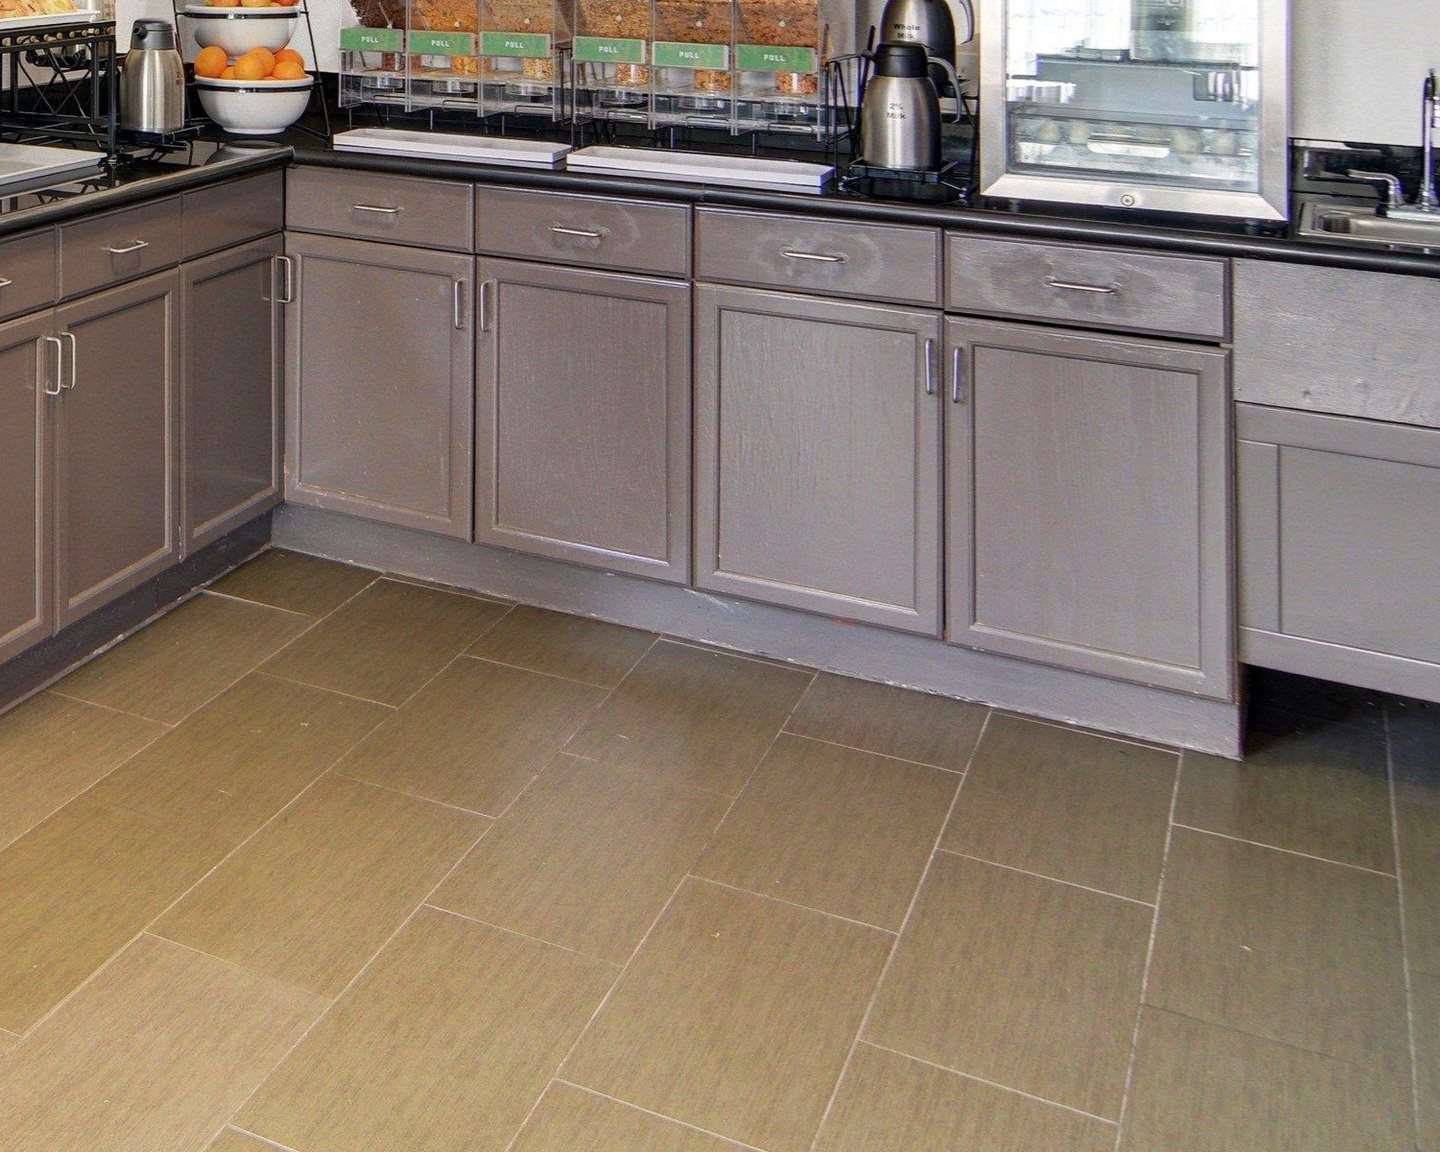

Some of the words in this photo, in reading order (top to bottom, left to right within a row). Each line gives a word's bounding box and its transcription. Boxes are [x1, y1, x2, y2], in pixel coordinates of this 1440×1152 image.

[361, 35, 380, 44] PULL
[431, 39, 450, 48] PULL
[504, 40, 525, 49] PULL
[598, 45, 619, 54] PULL
[679, 50, 701, 60] PULL
[763, 53, 786, 63] PULL
